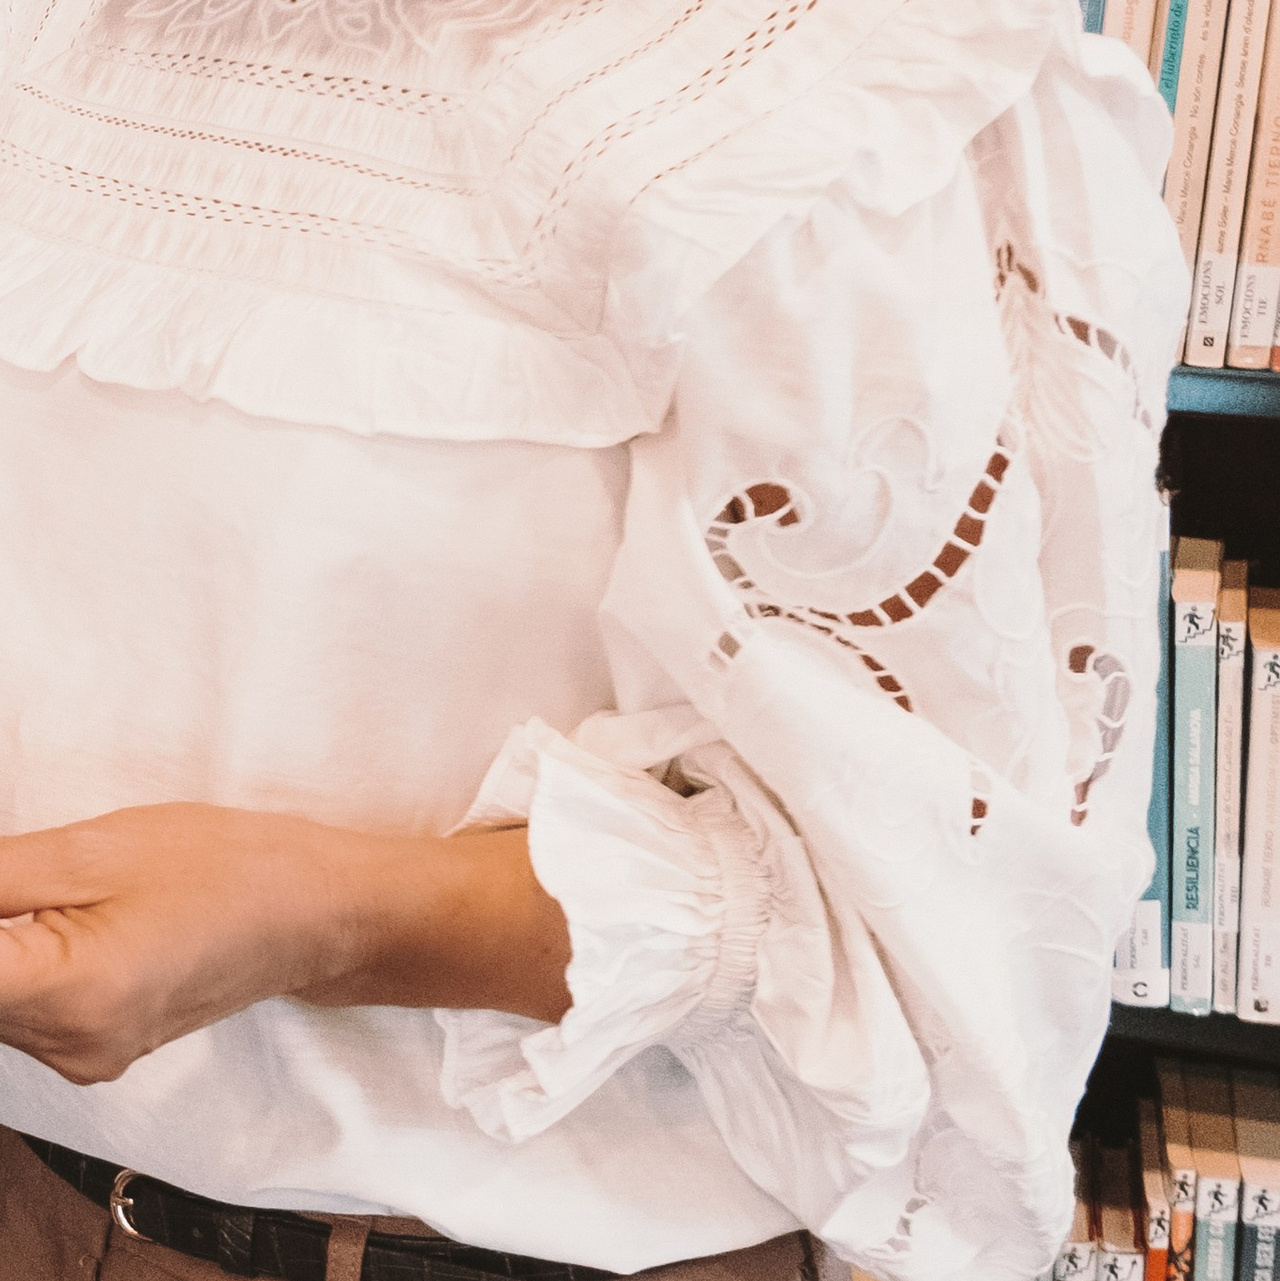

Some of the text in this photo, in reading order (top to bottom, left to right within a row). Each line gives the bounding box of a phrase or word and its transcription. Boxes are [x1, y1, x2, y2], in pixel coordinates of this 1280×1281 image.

[1170, 3, 1182, 18] de
[1255, 198, 1277, 264] RNABÉ
[1198, 260, 1214, 325] EMOCIONS
[1185, 826, 1201, 911] RESILIENCIA
